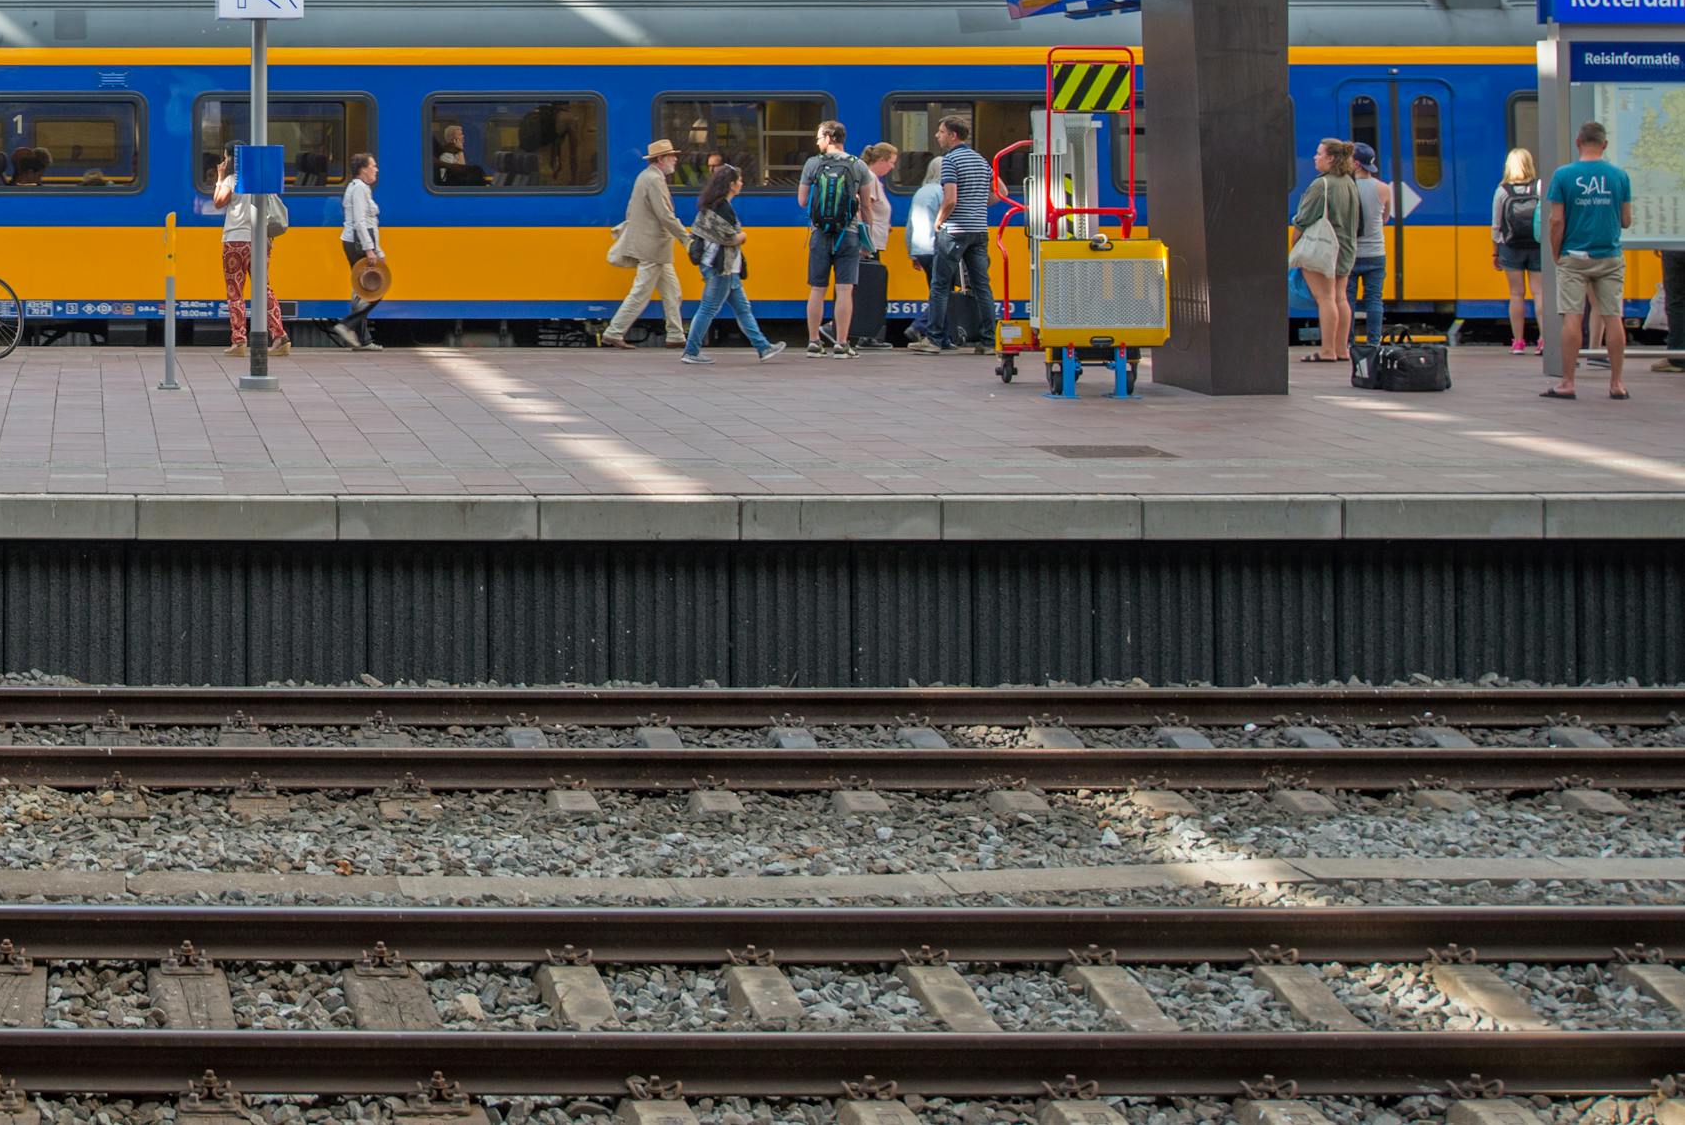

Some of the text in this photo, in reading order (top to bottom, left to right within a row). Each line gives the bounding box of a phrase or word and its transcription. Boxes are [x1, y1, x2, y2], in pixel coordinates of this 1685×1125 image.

[1584, 52, 1681, 65] Reisinformatie
[13, 114, 23, 134] 1
[1575, 175, 1612, 195] SAL
[902, 302, 918, 314] 61
